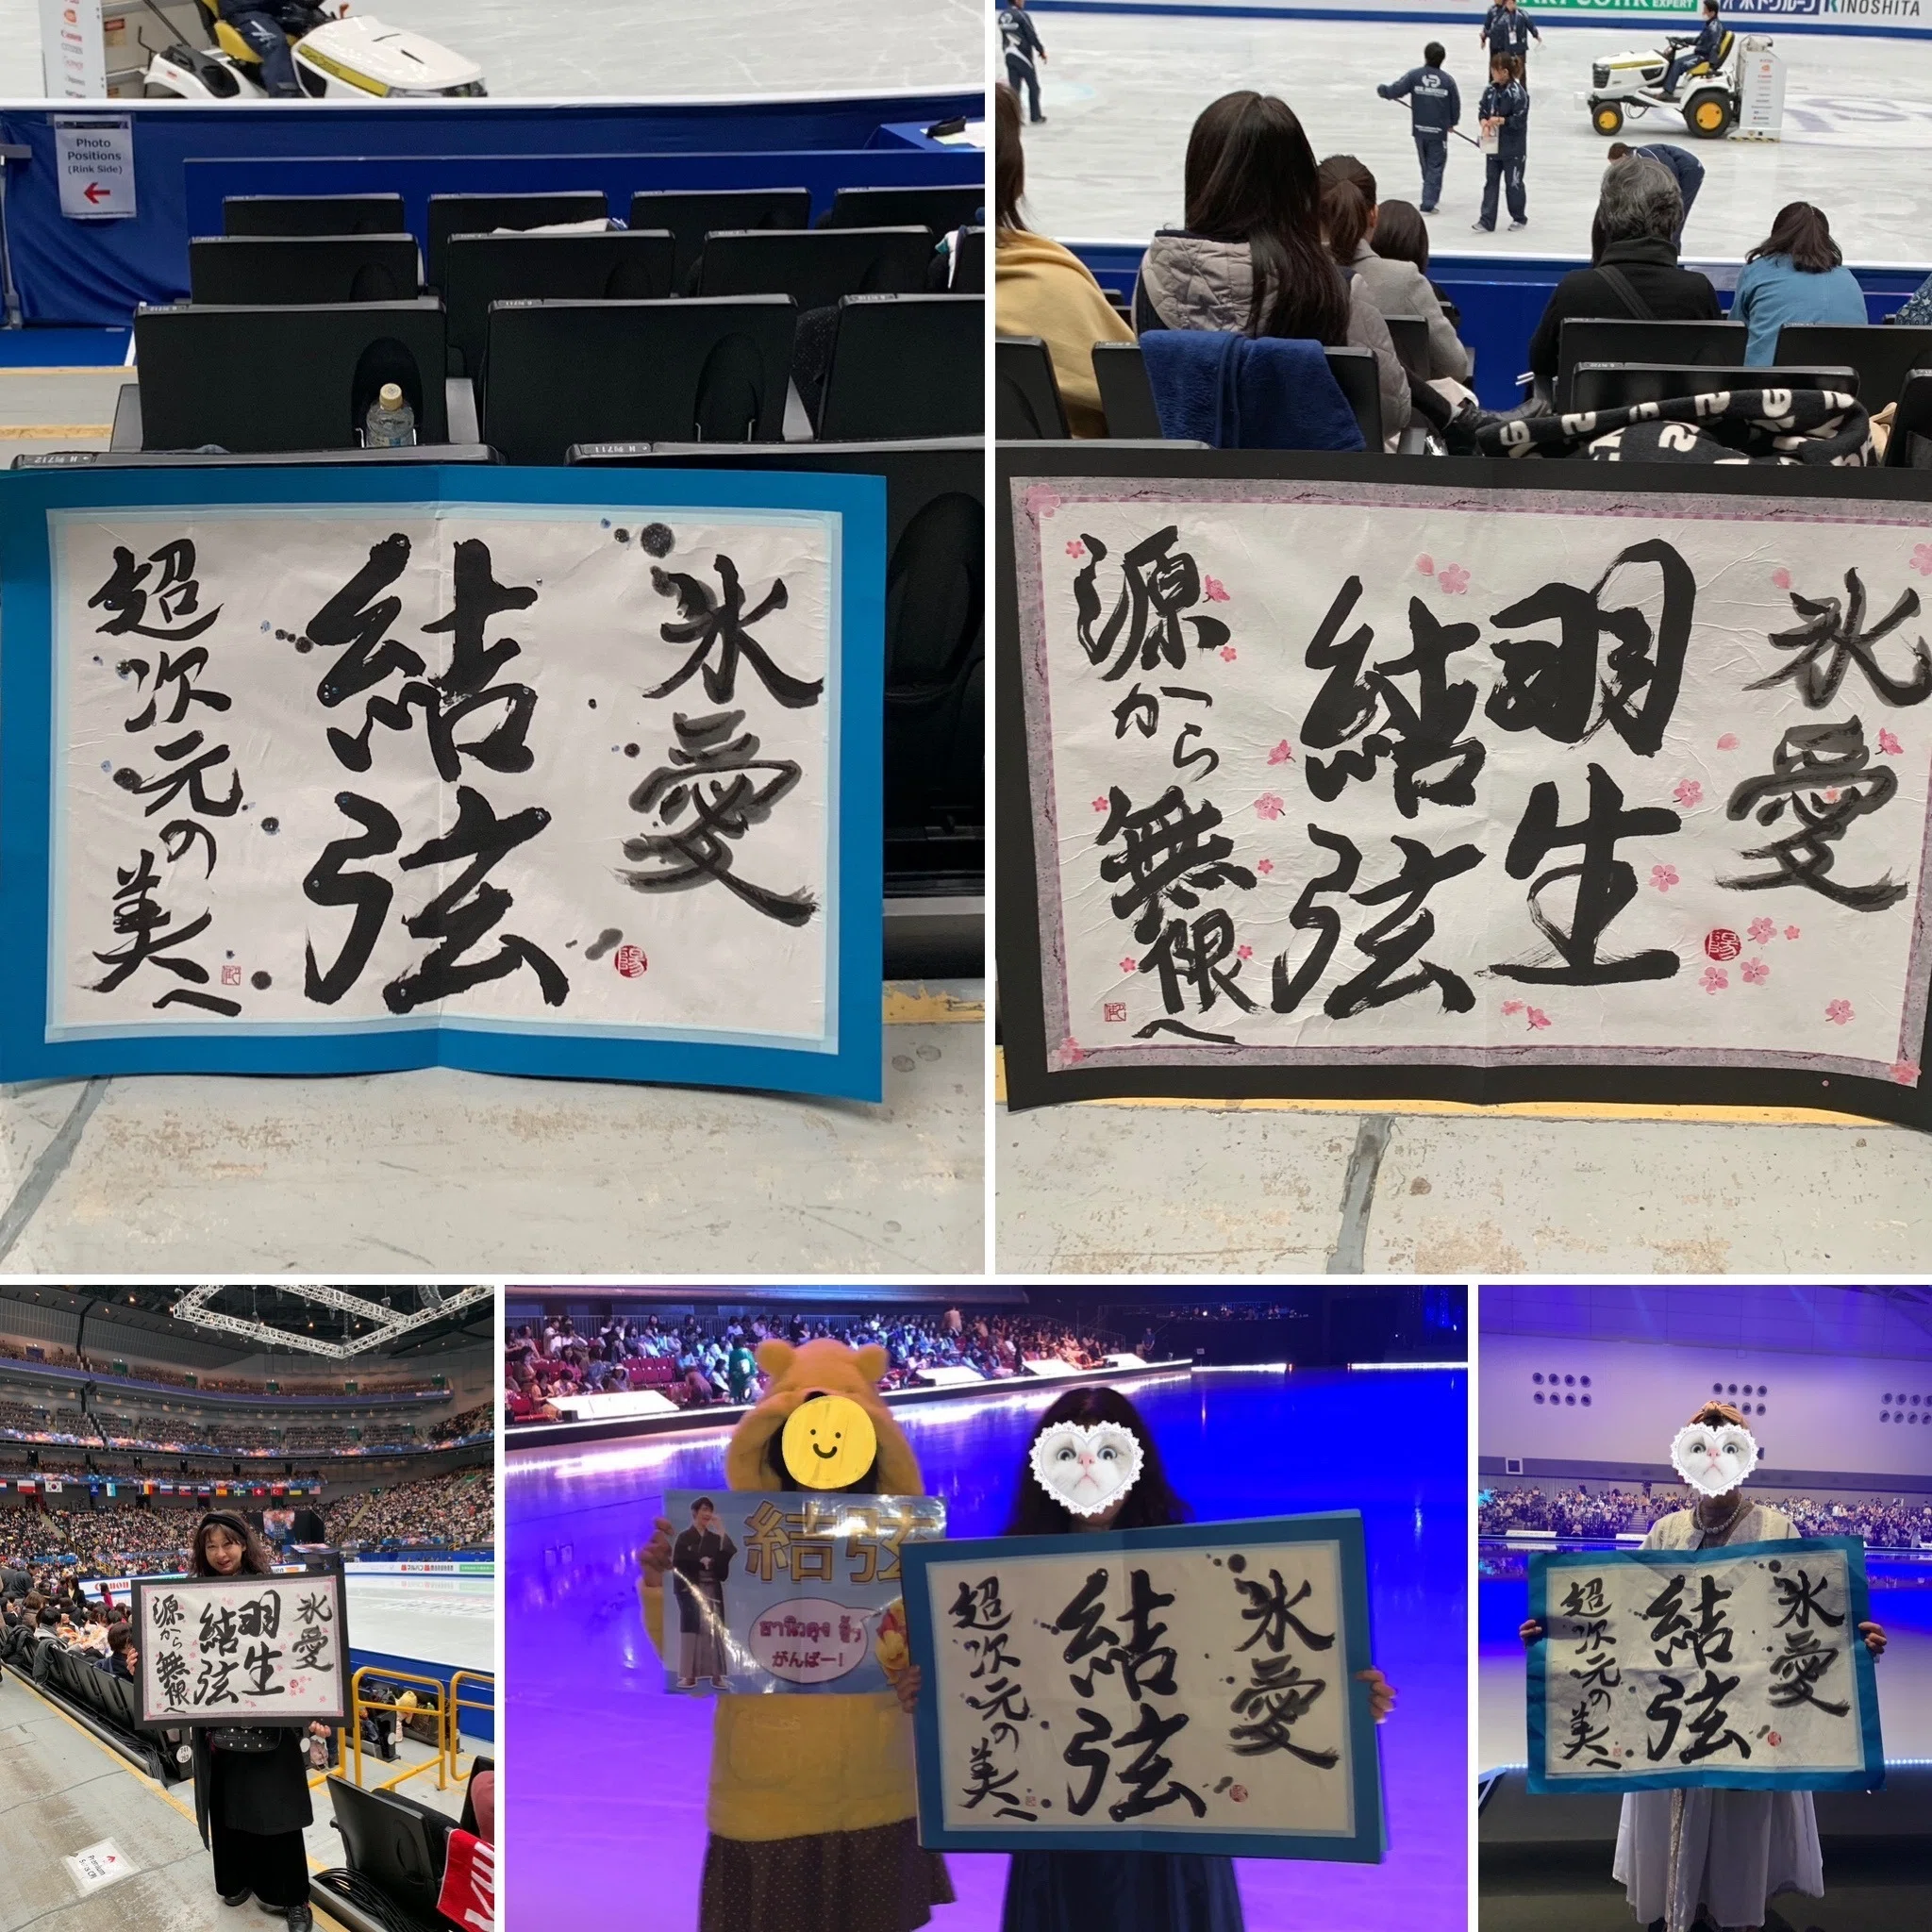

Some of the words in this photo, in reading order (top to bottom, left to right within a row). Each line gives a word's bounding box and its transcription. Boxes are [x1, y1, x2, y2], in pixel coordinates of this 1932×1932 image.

[1824, 0, 1920, 16] KINOSHITA
[76, 138, 111, 148] Photo
[67, 151, 122, 161] Positions
[68, 165, 94, 175] (Rink
[96, 165, 123, 175] Side)
[94, 1581, 129, 1591] Cnon
